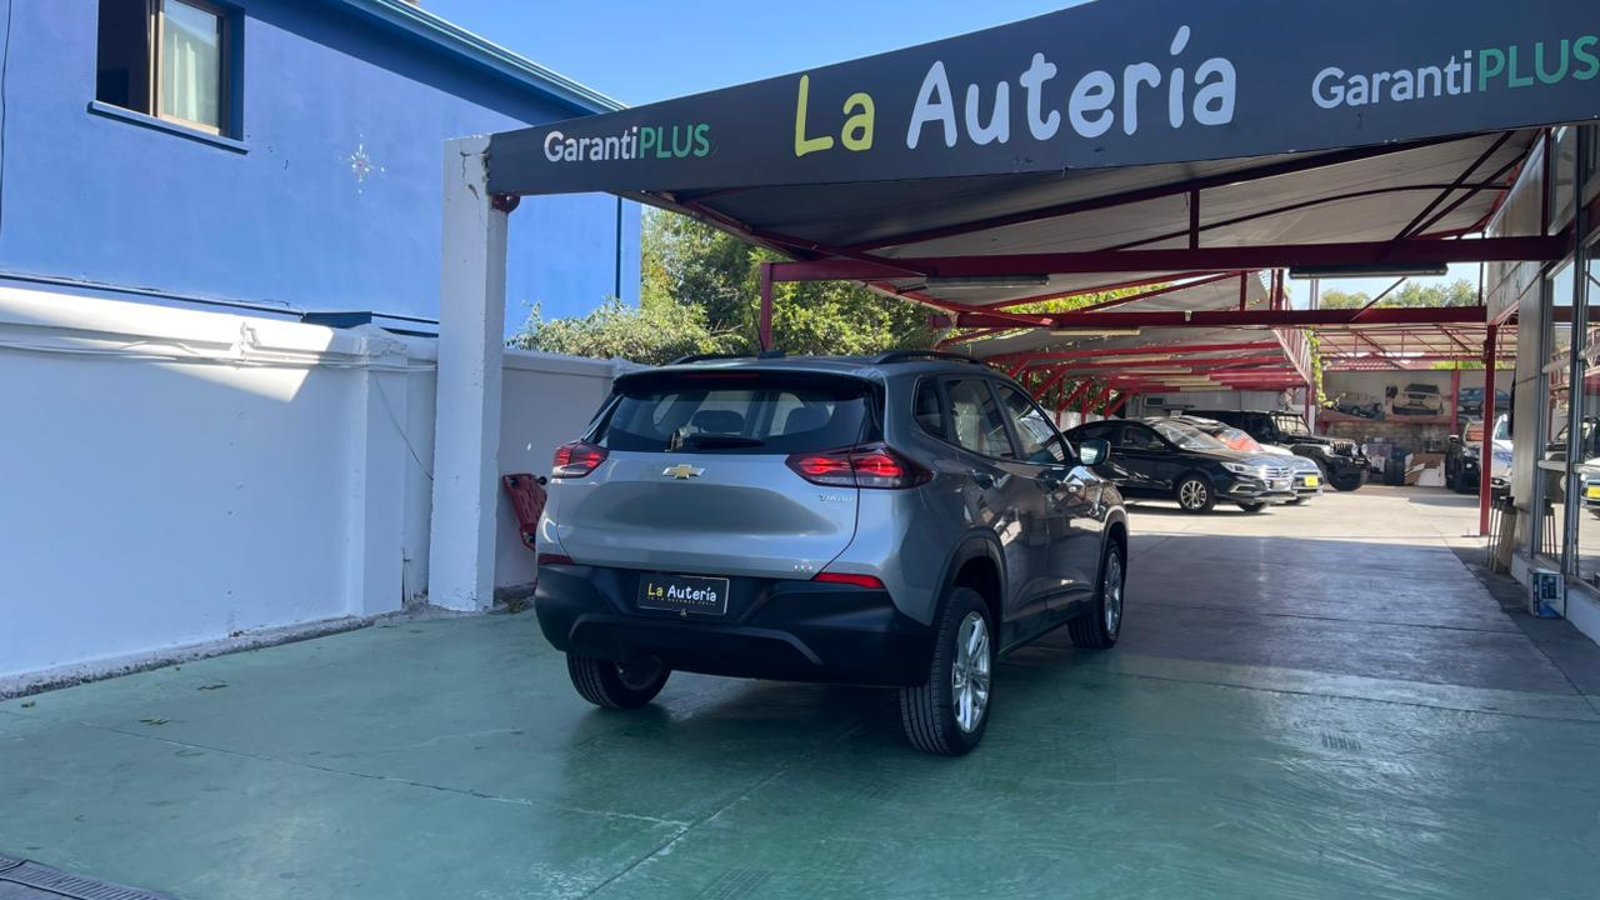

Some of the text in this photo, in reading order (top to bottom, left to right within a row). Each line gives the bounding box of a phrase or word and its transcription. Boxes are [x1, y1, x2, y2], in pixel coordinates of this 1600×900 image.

[794, 24, 1237, 157] La Autería
[1311, 35, 1600, 109] GarantiPLUS
[543, 123, 711, 163] GarantiPLUS
[648, 583, 664, 597] La
[667, 585, 717, 602] Autería
